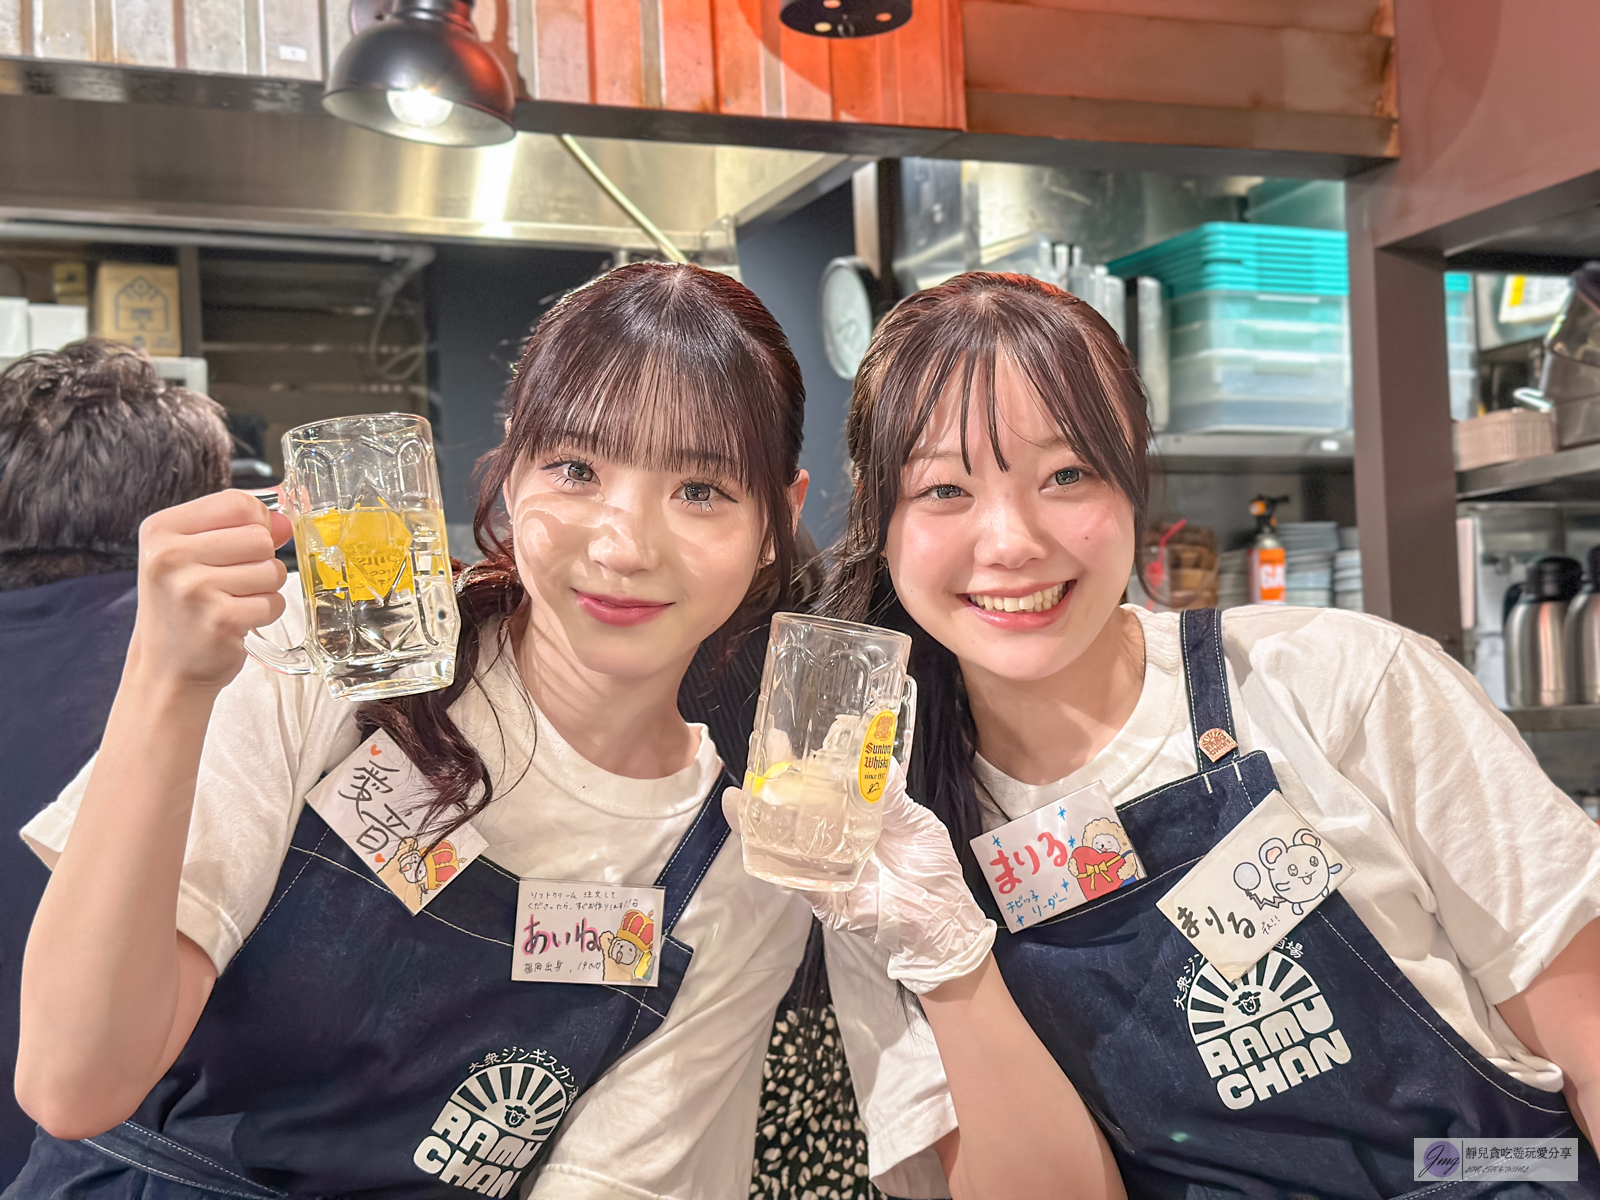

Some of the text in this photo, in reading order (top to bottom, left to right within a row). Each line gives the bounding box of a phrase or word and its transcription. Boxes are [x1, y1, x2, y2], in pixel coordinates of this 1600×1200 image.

[990, 832, 1068, 894] まりる
[522, 914, 601, 956] あいね
[1031, 893, 1067, 917] リーダー
[1177, 906, 1256, 938] まりる
[1197, 994, 1334, 1079] RAMU
[1216, 1029, 1352, 1110] CHAN
[431, 1100, 543, 1169] RAMU
[413, 1135, 522, 1199] CHAN
